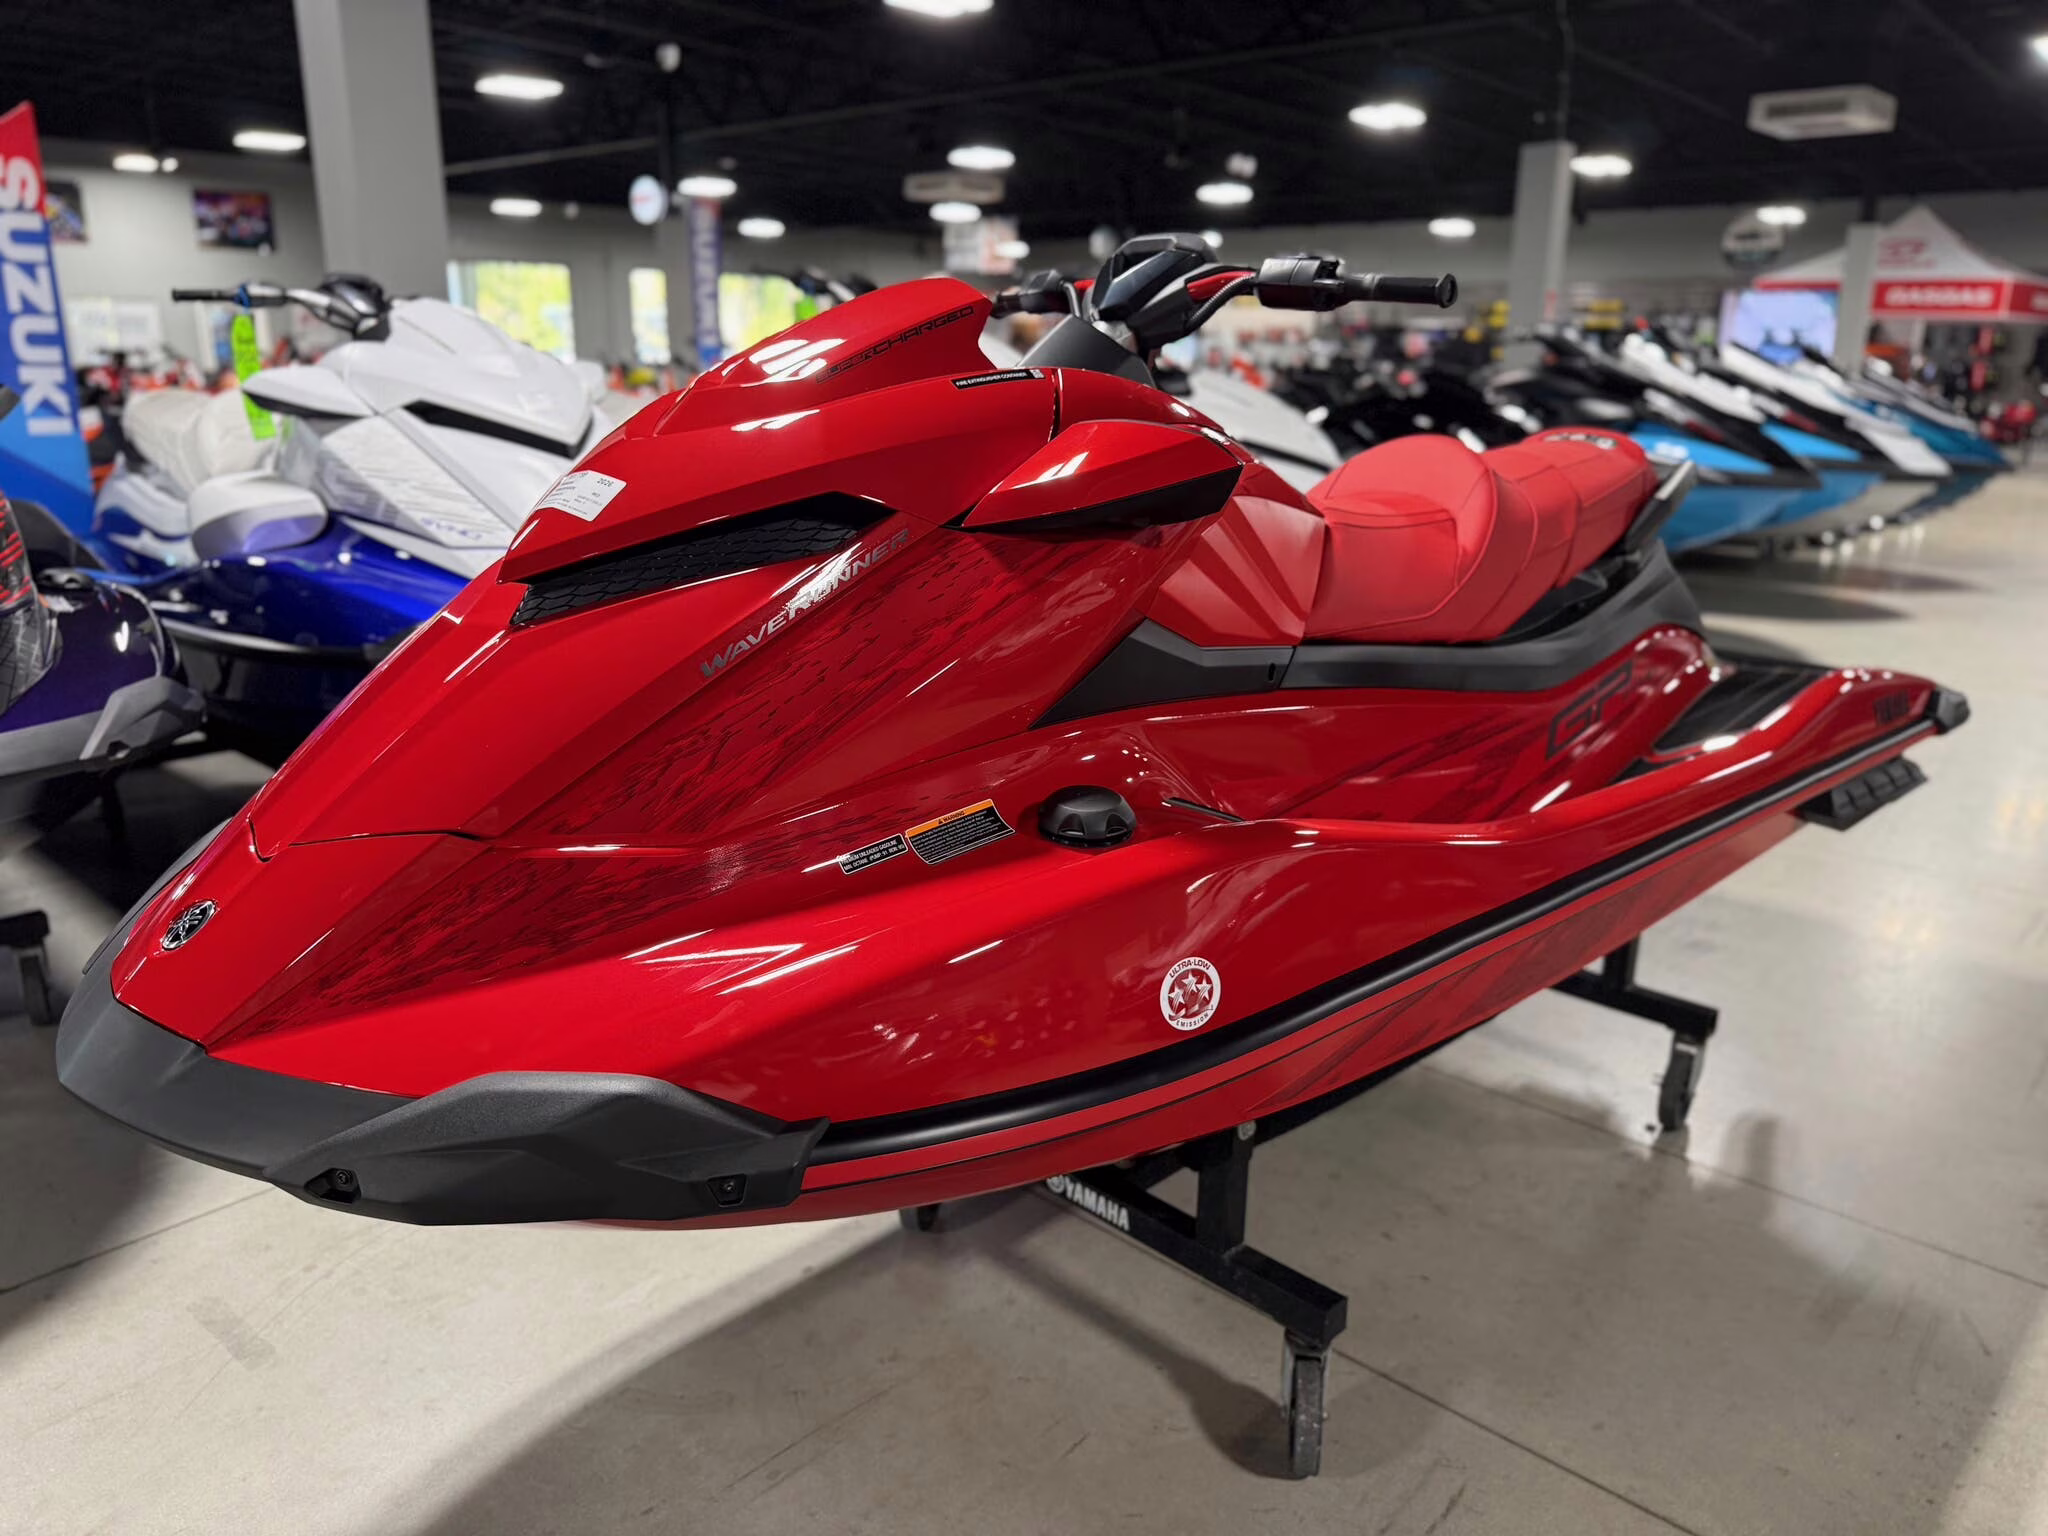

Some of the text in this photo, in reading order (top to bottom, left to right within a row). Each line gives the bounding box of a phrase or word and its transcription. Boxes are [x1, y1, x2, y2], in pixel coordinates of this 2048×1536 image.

[0, 156, 75, 436] SUZUKI
[815, 305, 975, 385] SUPERCHARGED
[701, 528, 909, 678] WAVERUNNER
[943, 810, 966, 823] WARNING
[1169, 958, 1212, 978] ULTRA-LOW
[1176, 1012, 1209, 1028] EMISSION
[1064, 1175, 1130, 1232] YAMAHA
